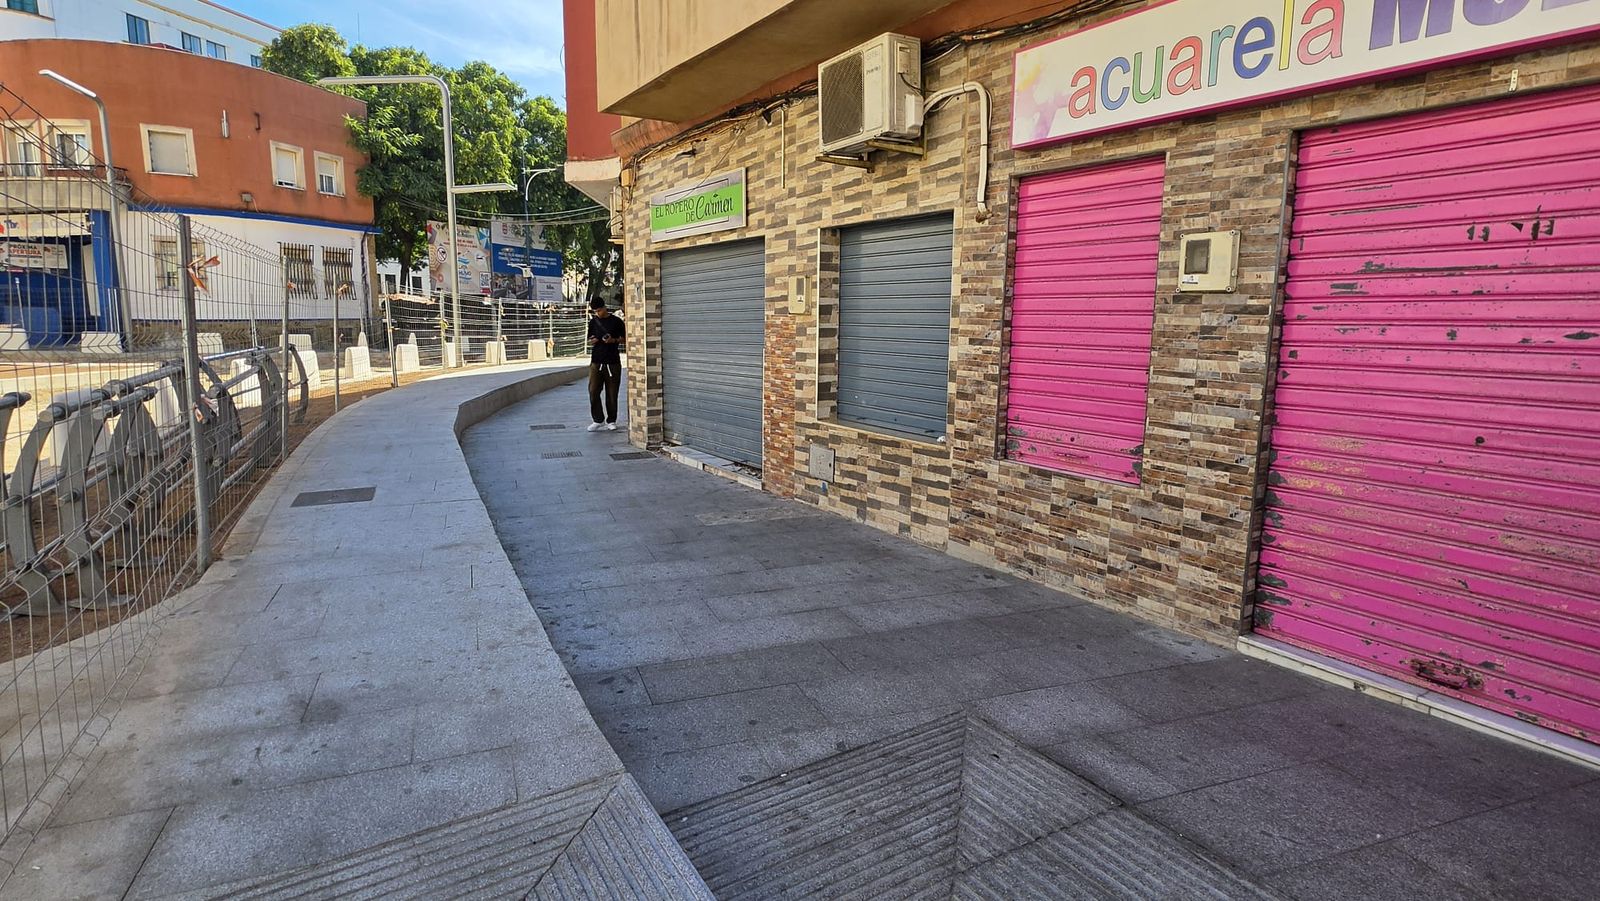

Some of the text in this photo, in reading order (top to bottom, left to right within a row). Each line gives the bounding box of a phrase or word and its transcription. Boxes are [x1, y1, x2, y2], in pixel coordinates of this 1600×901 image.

[1068, 0, 1345, 119] acuarela
[655, 198, 695, 218] EL ROPERO
[686, 194, 733, 222] DE Carmen
